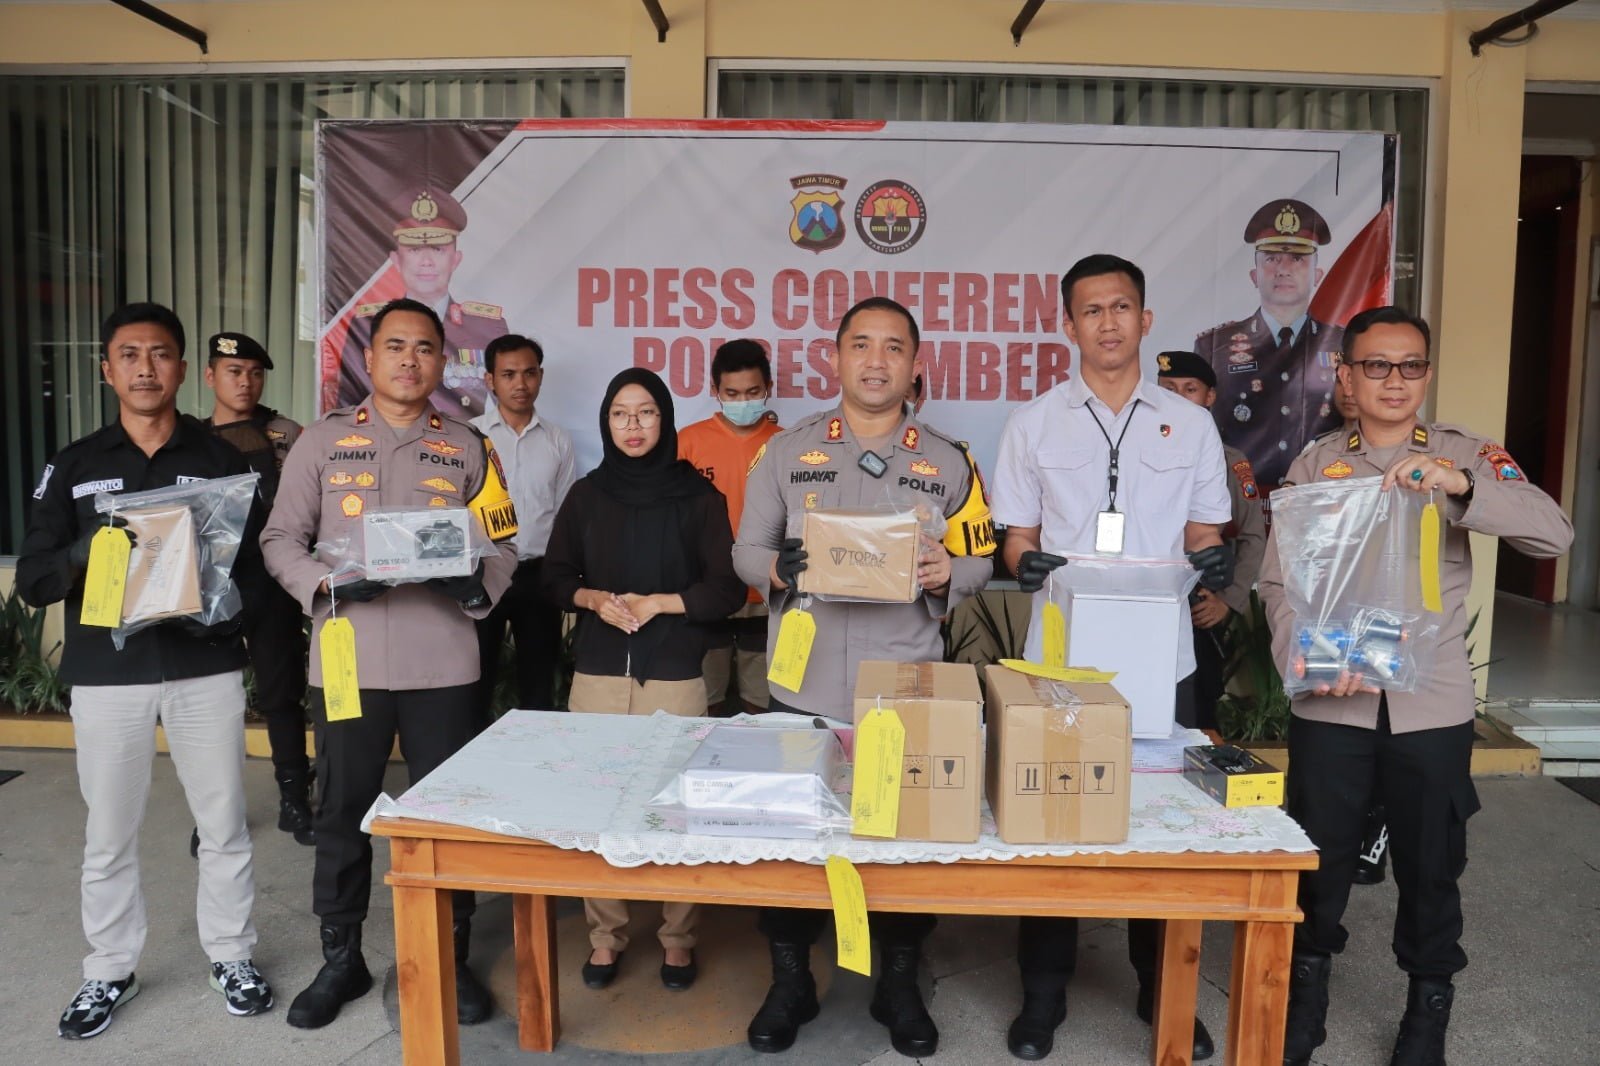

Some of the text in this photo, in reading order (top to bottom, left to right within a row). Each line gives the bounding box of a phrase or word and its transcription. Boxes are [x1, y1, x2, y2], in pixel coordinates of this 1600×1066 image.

[796, 175, 841, 187] JAWA TIMUR
[577, 267, 1064, 333] PRESS COFEREN
[633, 336, 1071, 401] POES MBER
[329, 451, 377, 461] JIMMY
[419, 452, 465, 470] POLRI
[790, 470, 838, 484] HIDAYAT
[898, 476, 946, 497] POLRI
[847, 550, 887, 564] TOPAZ
